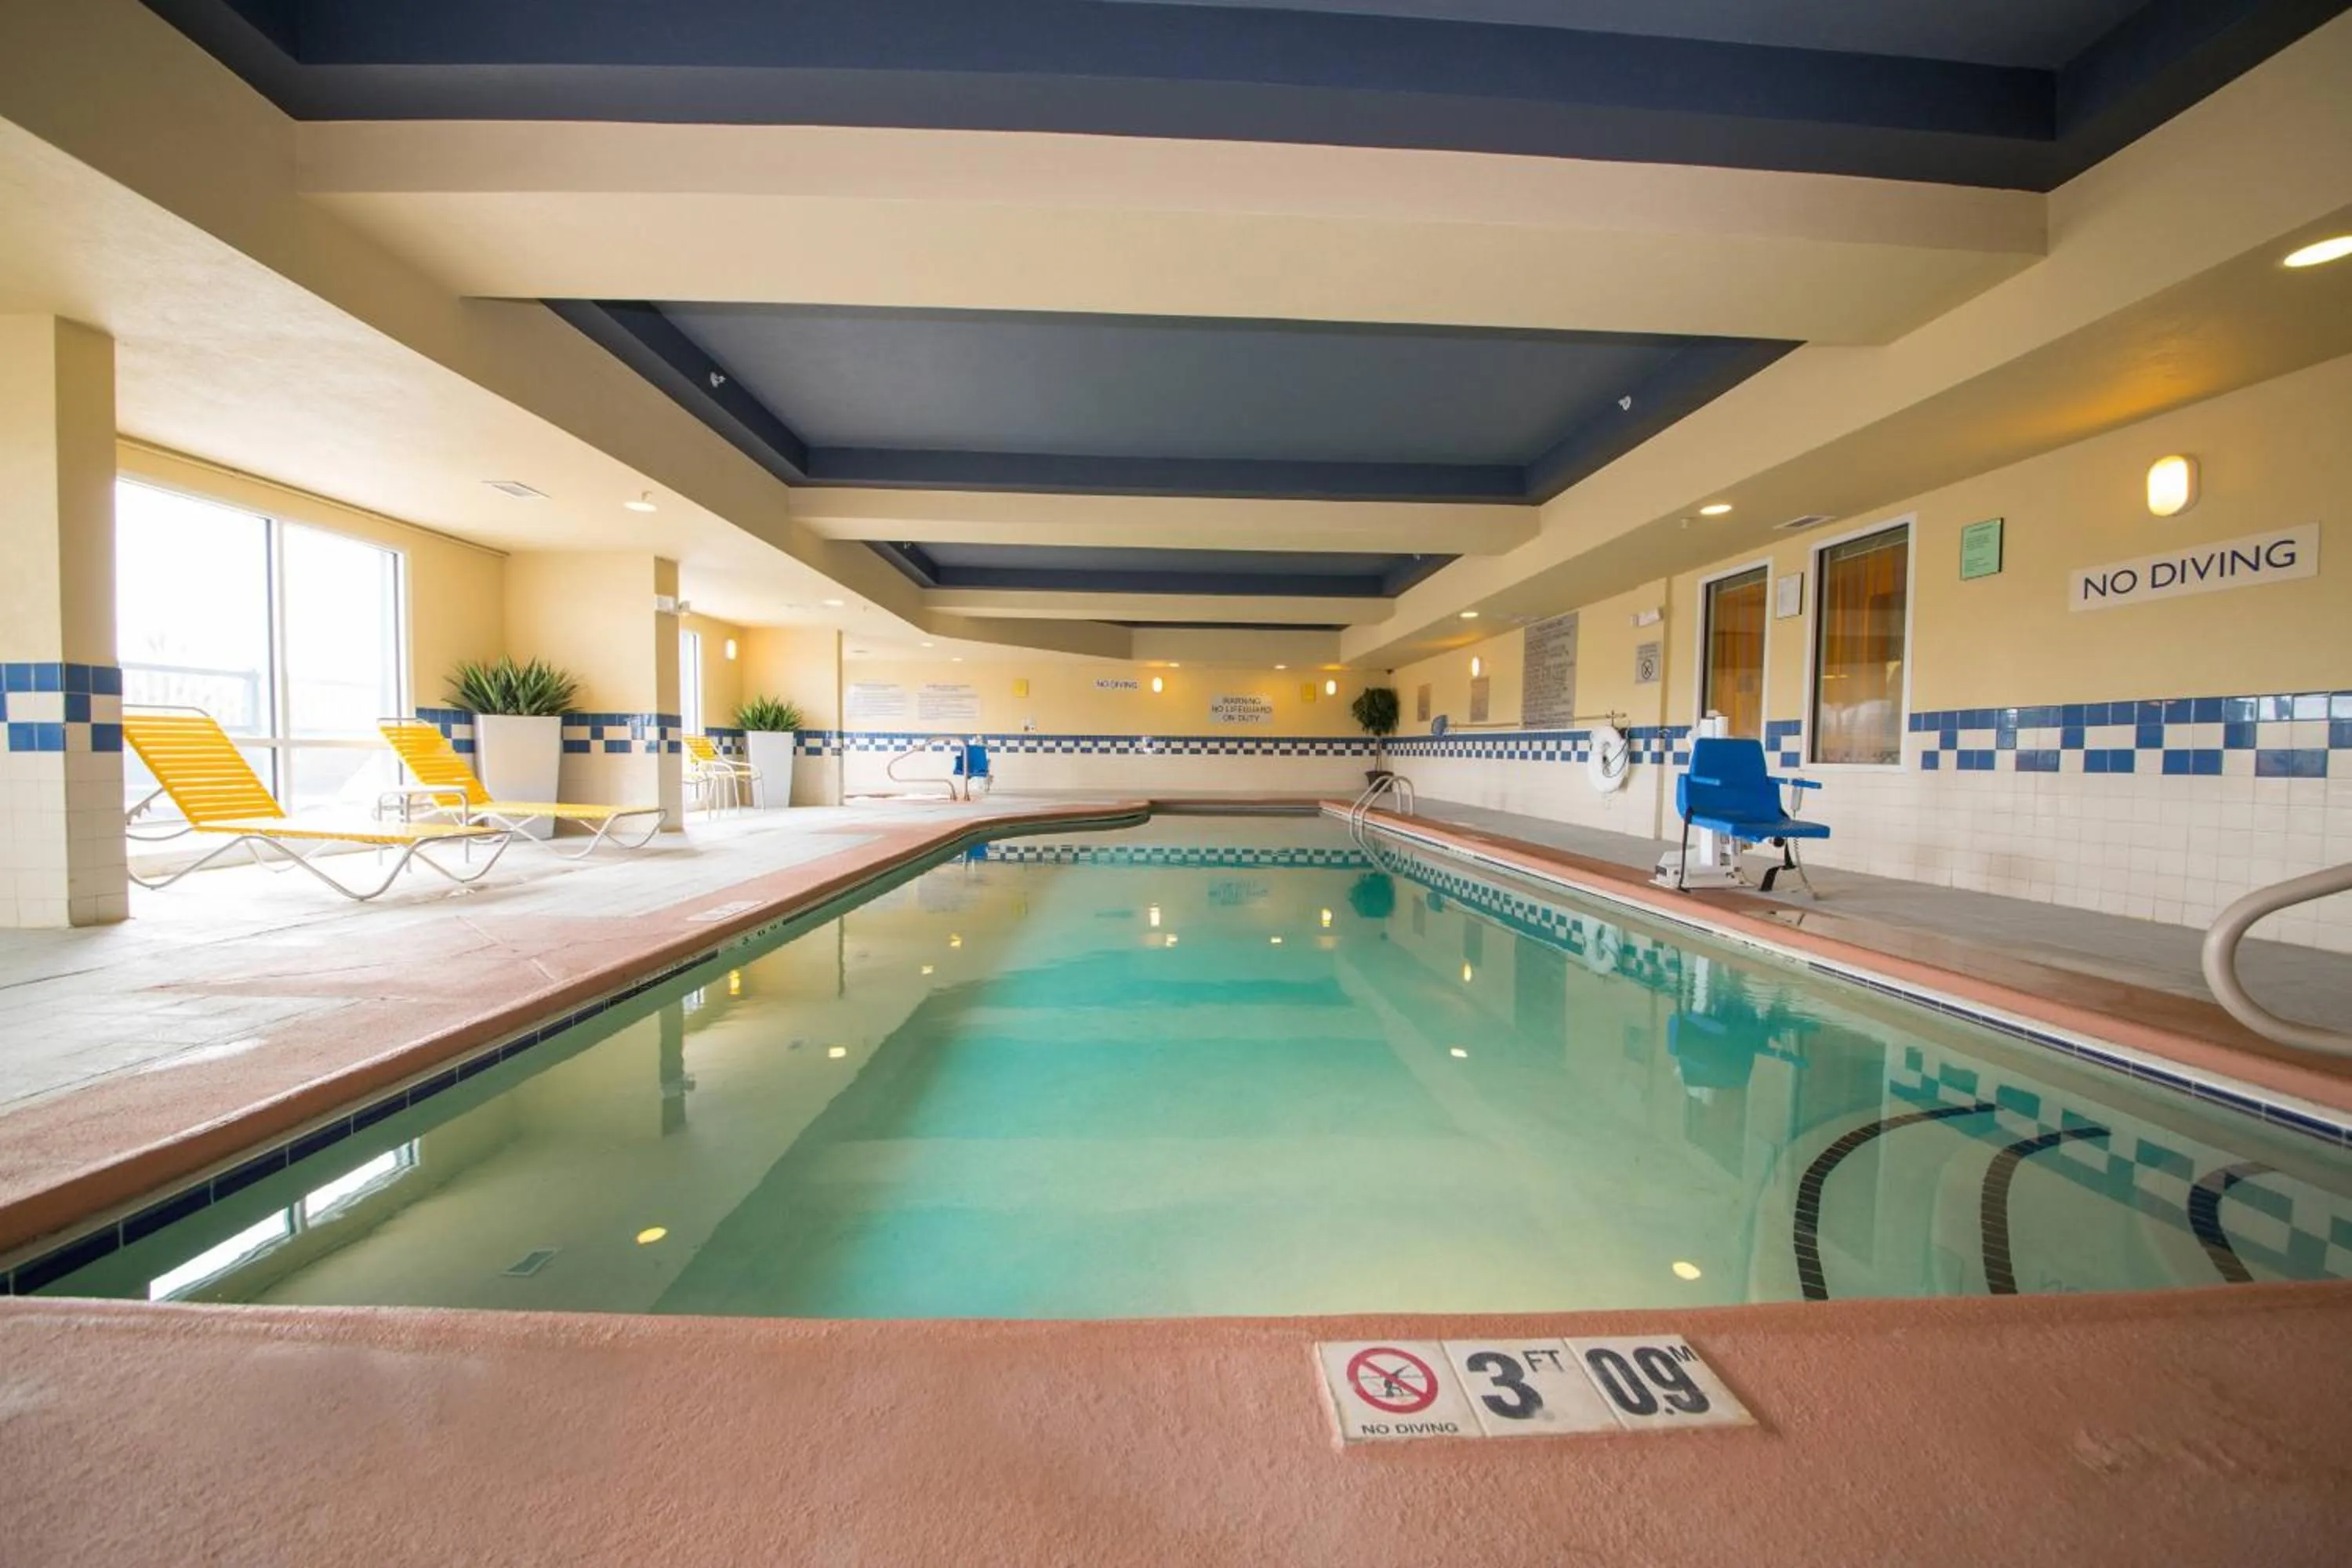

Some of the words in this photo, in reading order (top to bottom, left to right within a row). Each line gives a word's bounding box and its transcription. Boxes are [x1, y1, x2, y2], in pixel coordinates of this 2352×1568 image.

[2083, 570, 2138, 600] NO
[2151, 539, 2297, 590] DIVING
[1097, 679, 1109, 688] NO
[1110, 679, 1138, 689] DIVING
[1466, 1352, 1544, 1419] 3
[1522, 1349, 1566, 1373] FT
[1667, 1345, 1700, 1363] M
[1361, 1424, 1390, 1435] NO
[1395, 1422, 1458, 1434] DIVING
